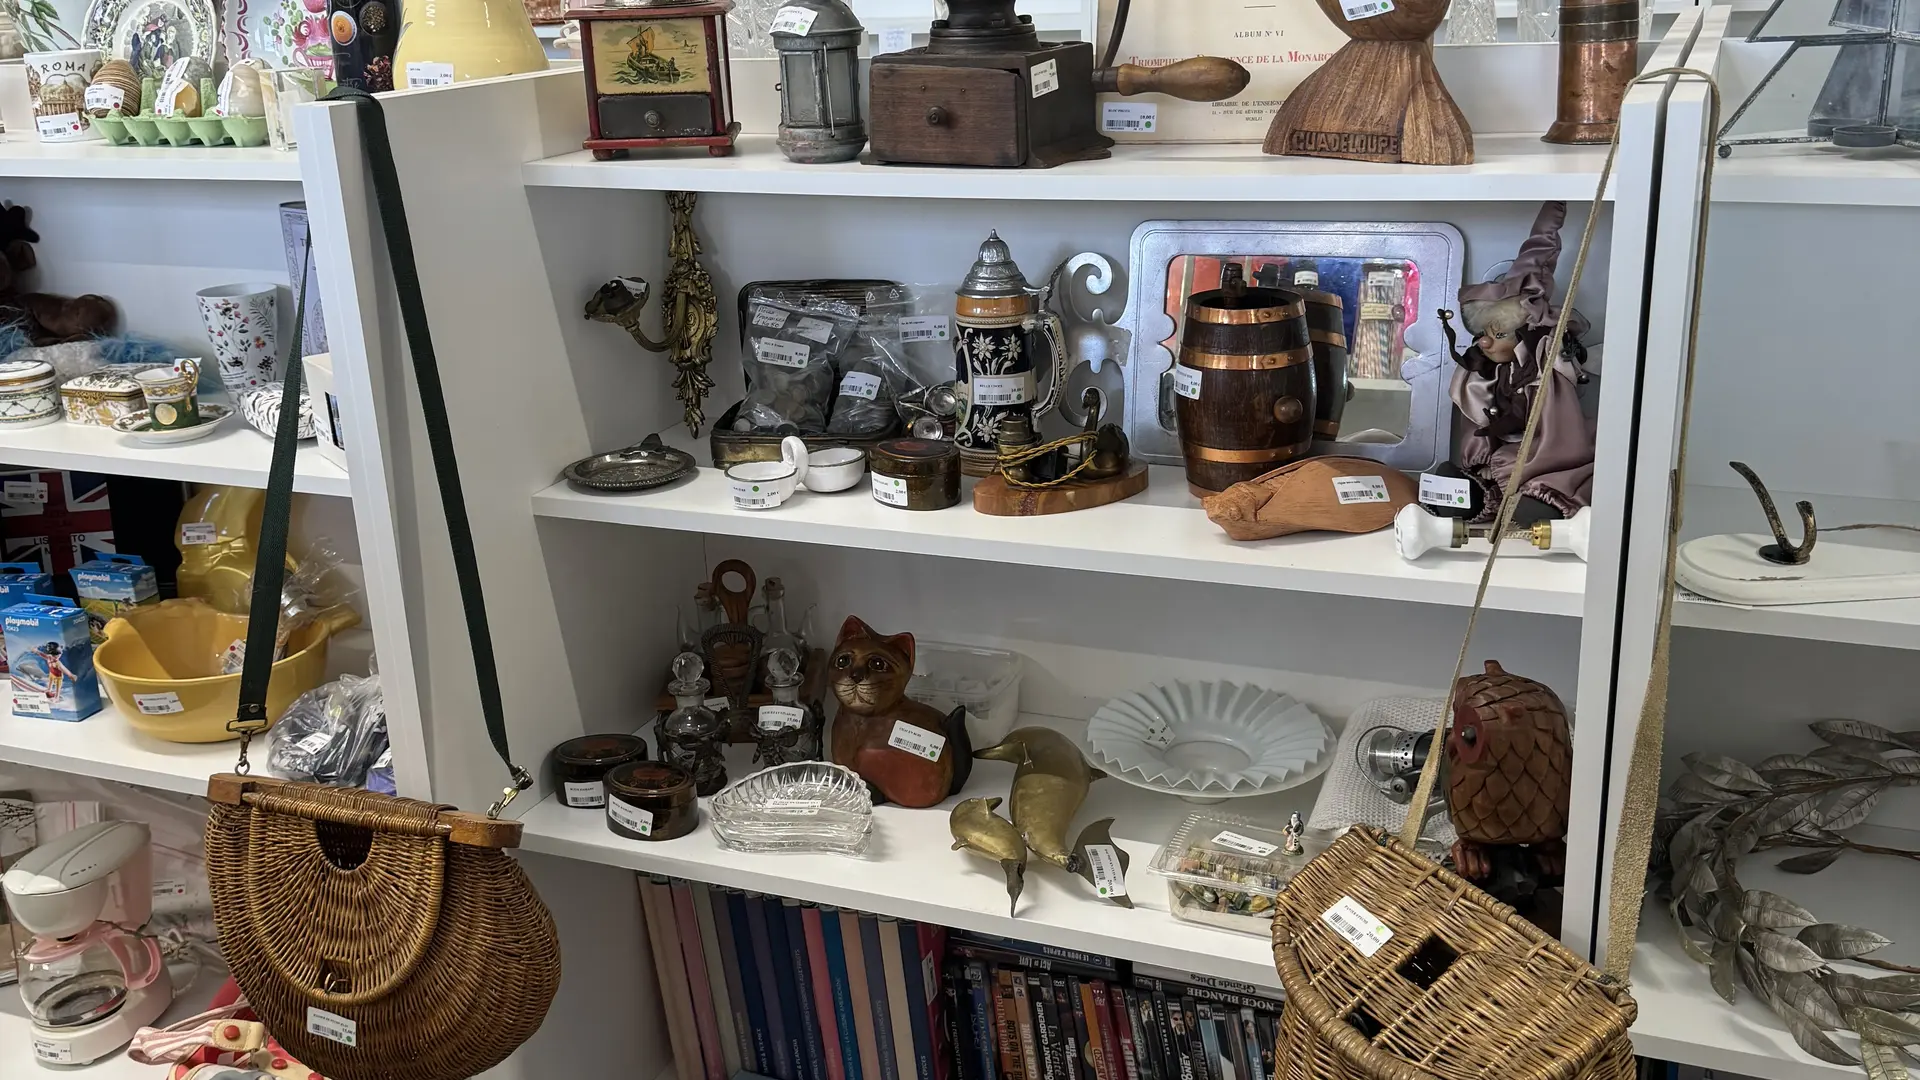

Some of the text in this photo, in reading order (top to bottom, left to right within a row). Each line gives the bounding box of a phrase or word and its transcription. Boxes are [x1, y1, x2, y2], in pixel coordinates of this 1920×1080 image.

[41, 61, 86, 74] ROMA
[1292, 130, 1399, 154] GUADELOUPE
[72, 534, 86, 542] TO
[78, 572, 110, 582] playmobil
[5, 616, 39, 626] playmobil
[1040, 959, 1052, 970] ACT
[1190, 973, 1257, 994] Grands Ducs
[1187, 987, 1274, 1010] NOCE BLANCHE
[1007, 1020, 1018, 1040] BOYS
[1010, 1041, 1018, 1052] ON
[1022, 1024, 1038, 1078] CLAIR DE LUNE
[1036, 1002, 1054, 1080] ONSTANT GARDENER
[1048, 1025, 1065, 1076] La Vérité
[1094, 1048, 1107, 1080] ANTED
